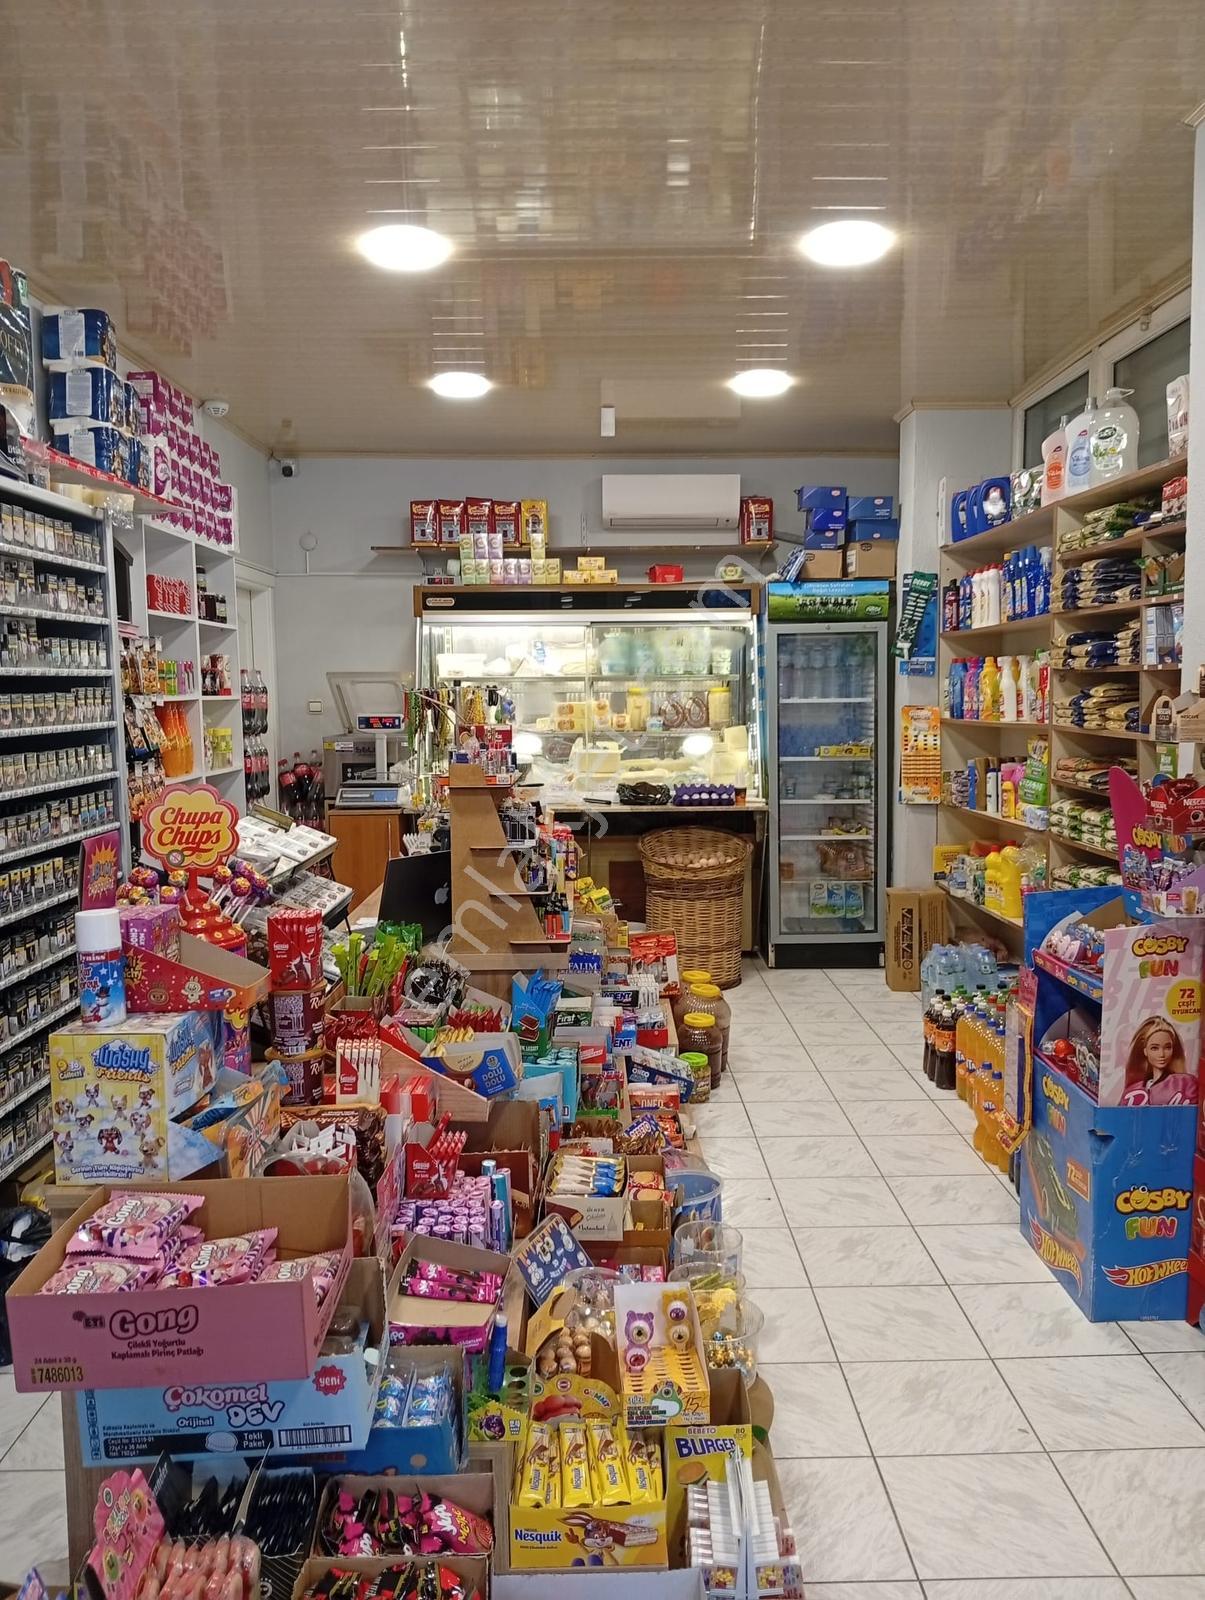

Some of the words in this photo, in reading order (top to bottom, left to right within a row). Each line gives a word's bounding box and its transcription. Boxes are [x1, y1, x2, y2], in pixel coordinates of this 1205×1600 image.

[160, 807, 223, 830] Chupa
[158, 826, 222, 854] Chups
[1132, 934, 1189, 957] COSBY
[1139, 959, 1179, 979] FUN
[1179, 988, 1195, 999] 72
[557, 1014, 575, 1023] First
[1115, 1186, 1193, 1214] COSBY
[106, 1199, 140, 1227] Gong
[1125, 1215, 1177, 1241] FUN
[191, 1243, 217, 1270] Gong
[278, 1262, 296, 1280] ong
[109, 1304, 199, 1340] Gong
[153, 1339, 186, 1348] Yoğurtlu
[111, 1350, 150, 1361] Kaplamalı
[152, 1349, 175, 1359] Pirinç
[38, 1366, 84, 1384] 7486013
[319, 1375, 341, 1388] yeni
[163, 1383, 268, 1412] Çokomel
[177, 1416, 214, 1429] Orijinal
[227, 1400, 285, 1429] DEV
[243, 1433, 263, 1441] Tekli
[243, 1440, 265, 1449] Paket
[675, 1437, 737, 1459] BURGER
[514, 1528, 562, 1544] Nesquik
